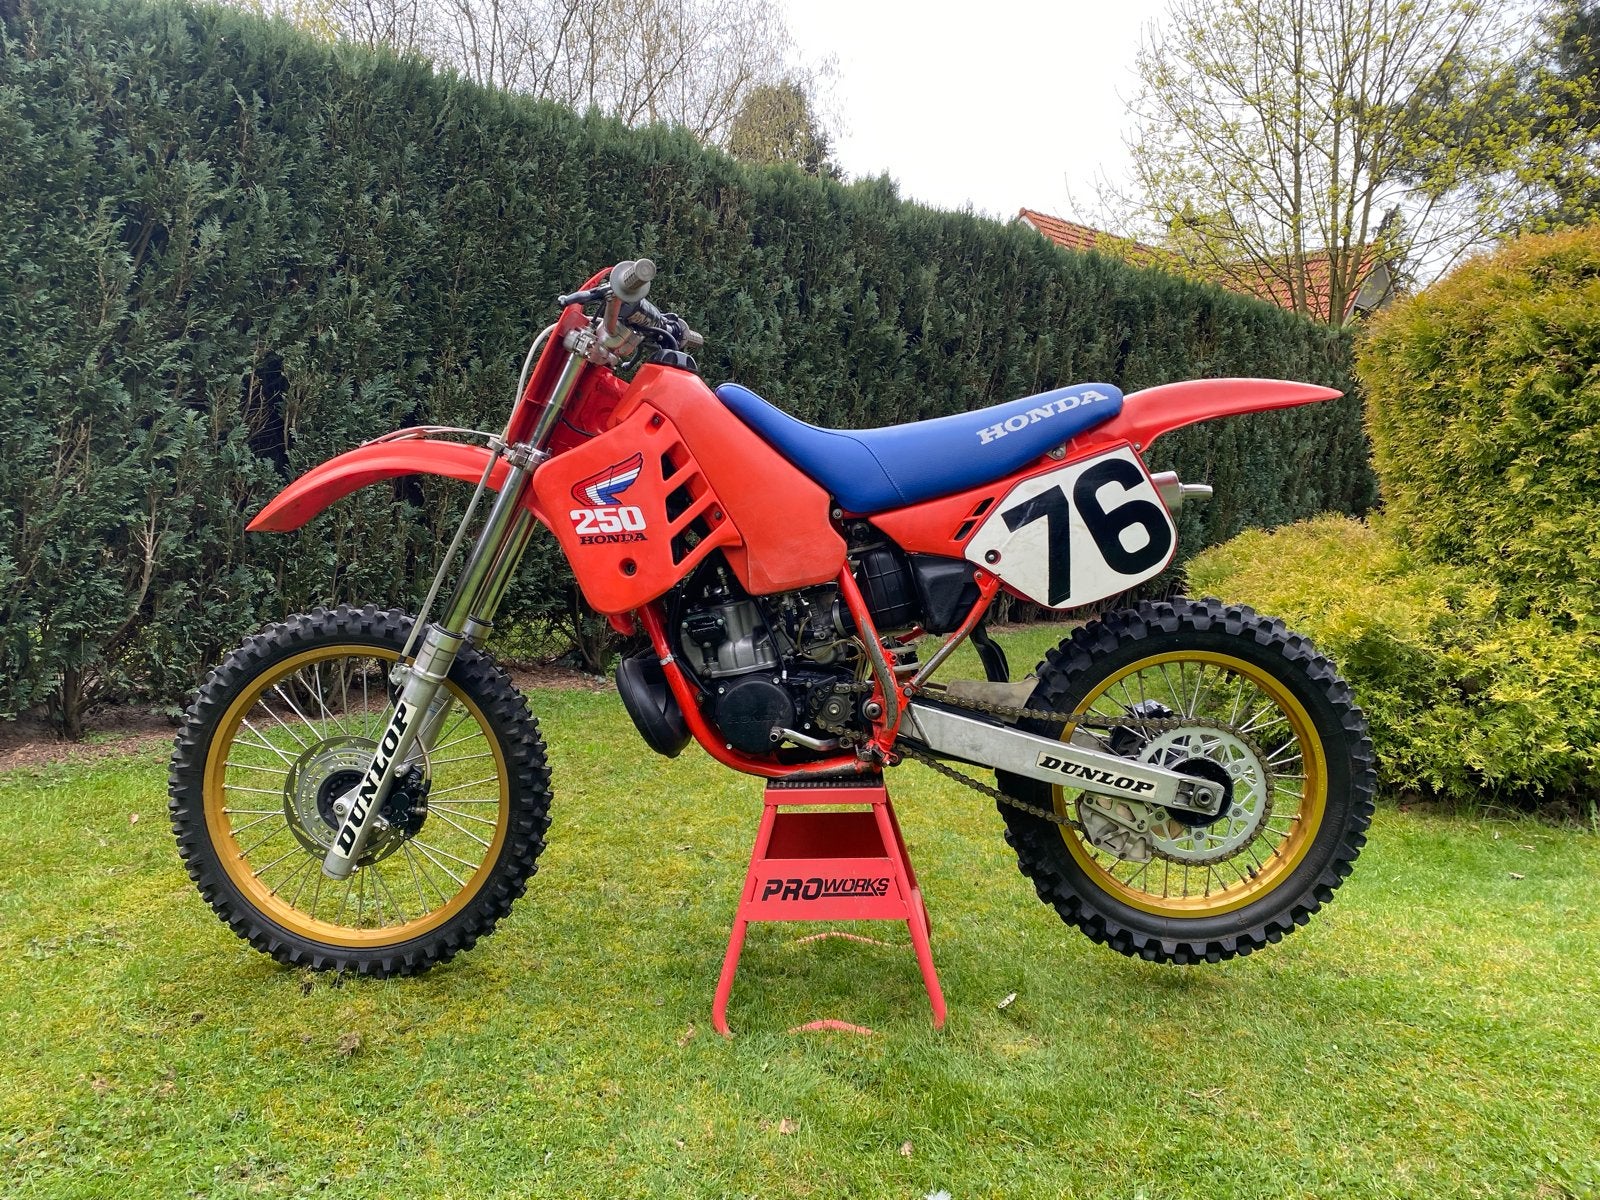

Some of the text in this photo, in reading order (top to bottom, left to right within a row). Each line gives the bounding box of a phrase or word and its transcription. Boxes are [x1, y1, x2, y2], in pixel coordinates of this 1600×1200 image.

[976, 390, 1109, 445] HONDA
[569, 505, 647, 536] 250
[580, 532, 648, 545] HONDA
[1001, 458, 1172, 607] 76
[337, 702, 408, 857] DUNLOP
[1039, 756, 1155, 794] DUNLOP
